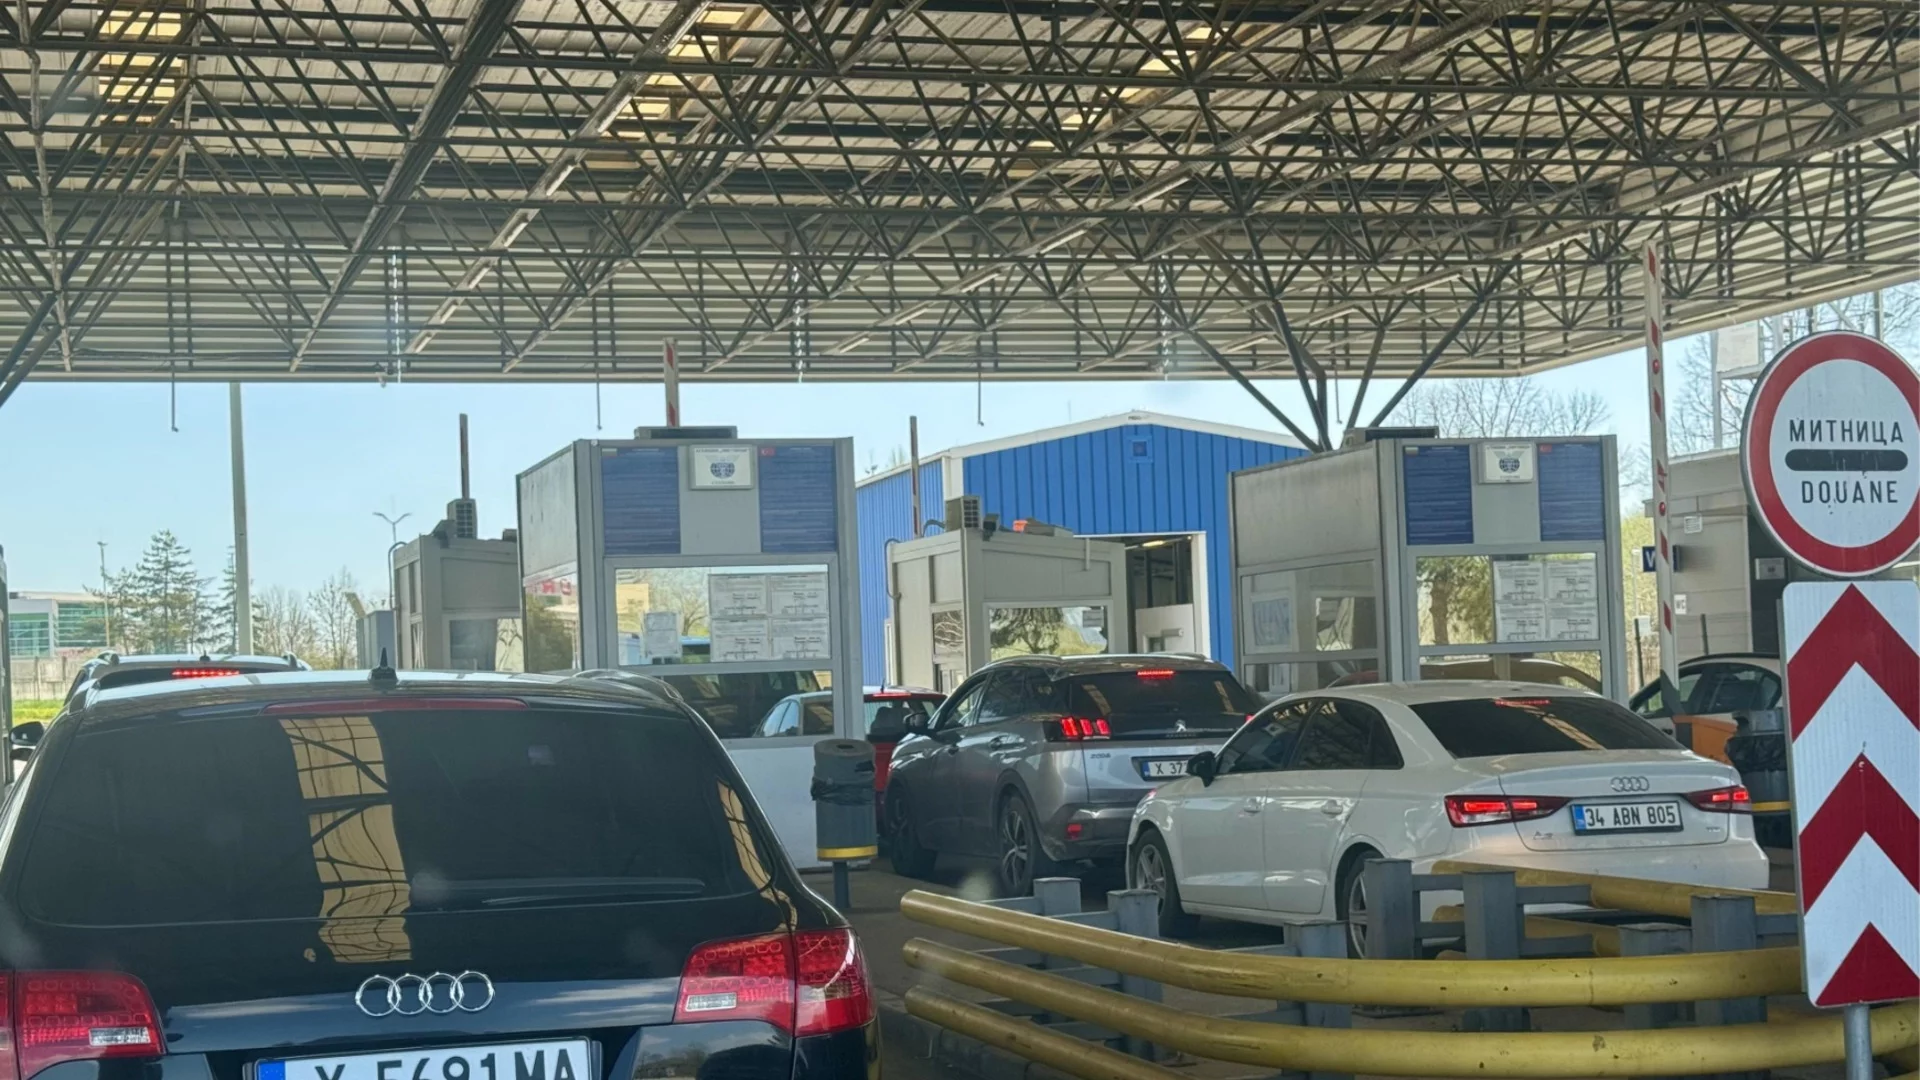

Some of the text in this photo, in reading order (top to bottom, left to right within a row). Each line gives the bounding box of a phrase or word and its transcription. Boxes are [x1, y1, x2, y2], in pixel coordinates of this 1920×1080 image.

[1789, 419, 1904, 446] МИТНИЦА
[1801, 480, 1899, 503] DOUANE
[1155, 761, 1188, 775] X 37
[1585, 805, 1676, 827] 34 ABN 805
